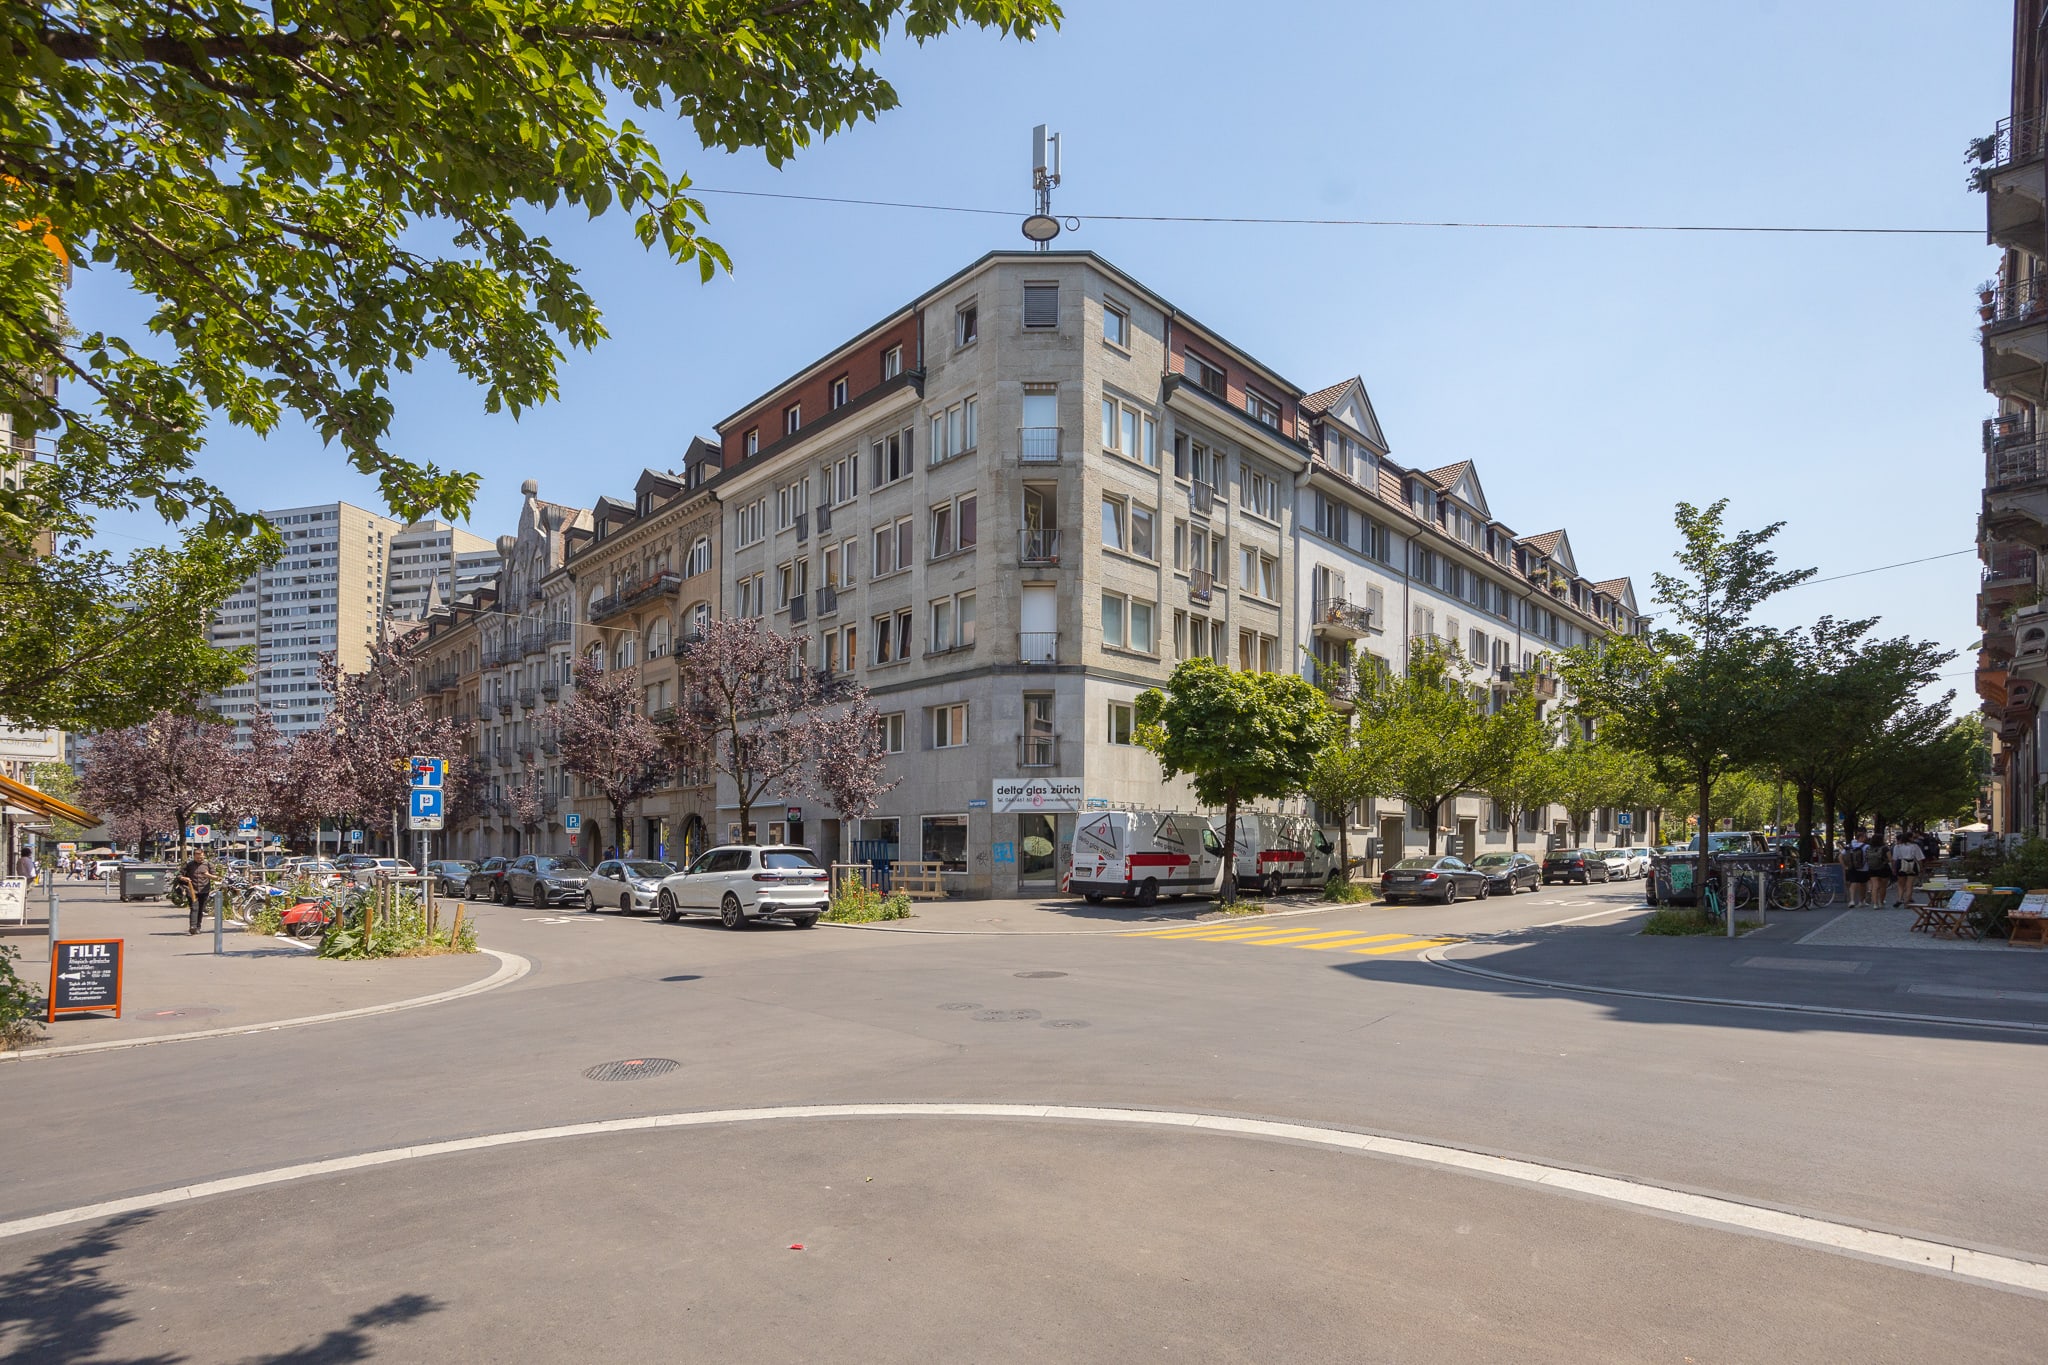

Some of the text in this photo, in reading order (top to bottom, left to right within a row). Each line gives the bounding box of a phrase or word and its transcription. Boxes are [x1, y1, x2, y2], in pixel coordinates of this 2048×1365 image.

[997, 785, 1081, 797] delta glas zürich
[420, 794, 433, 813] P
[69, 944, 111, 958] FILFL
